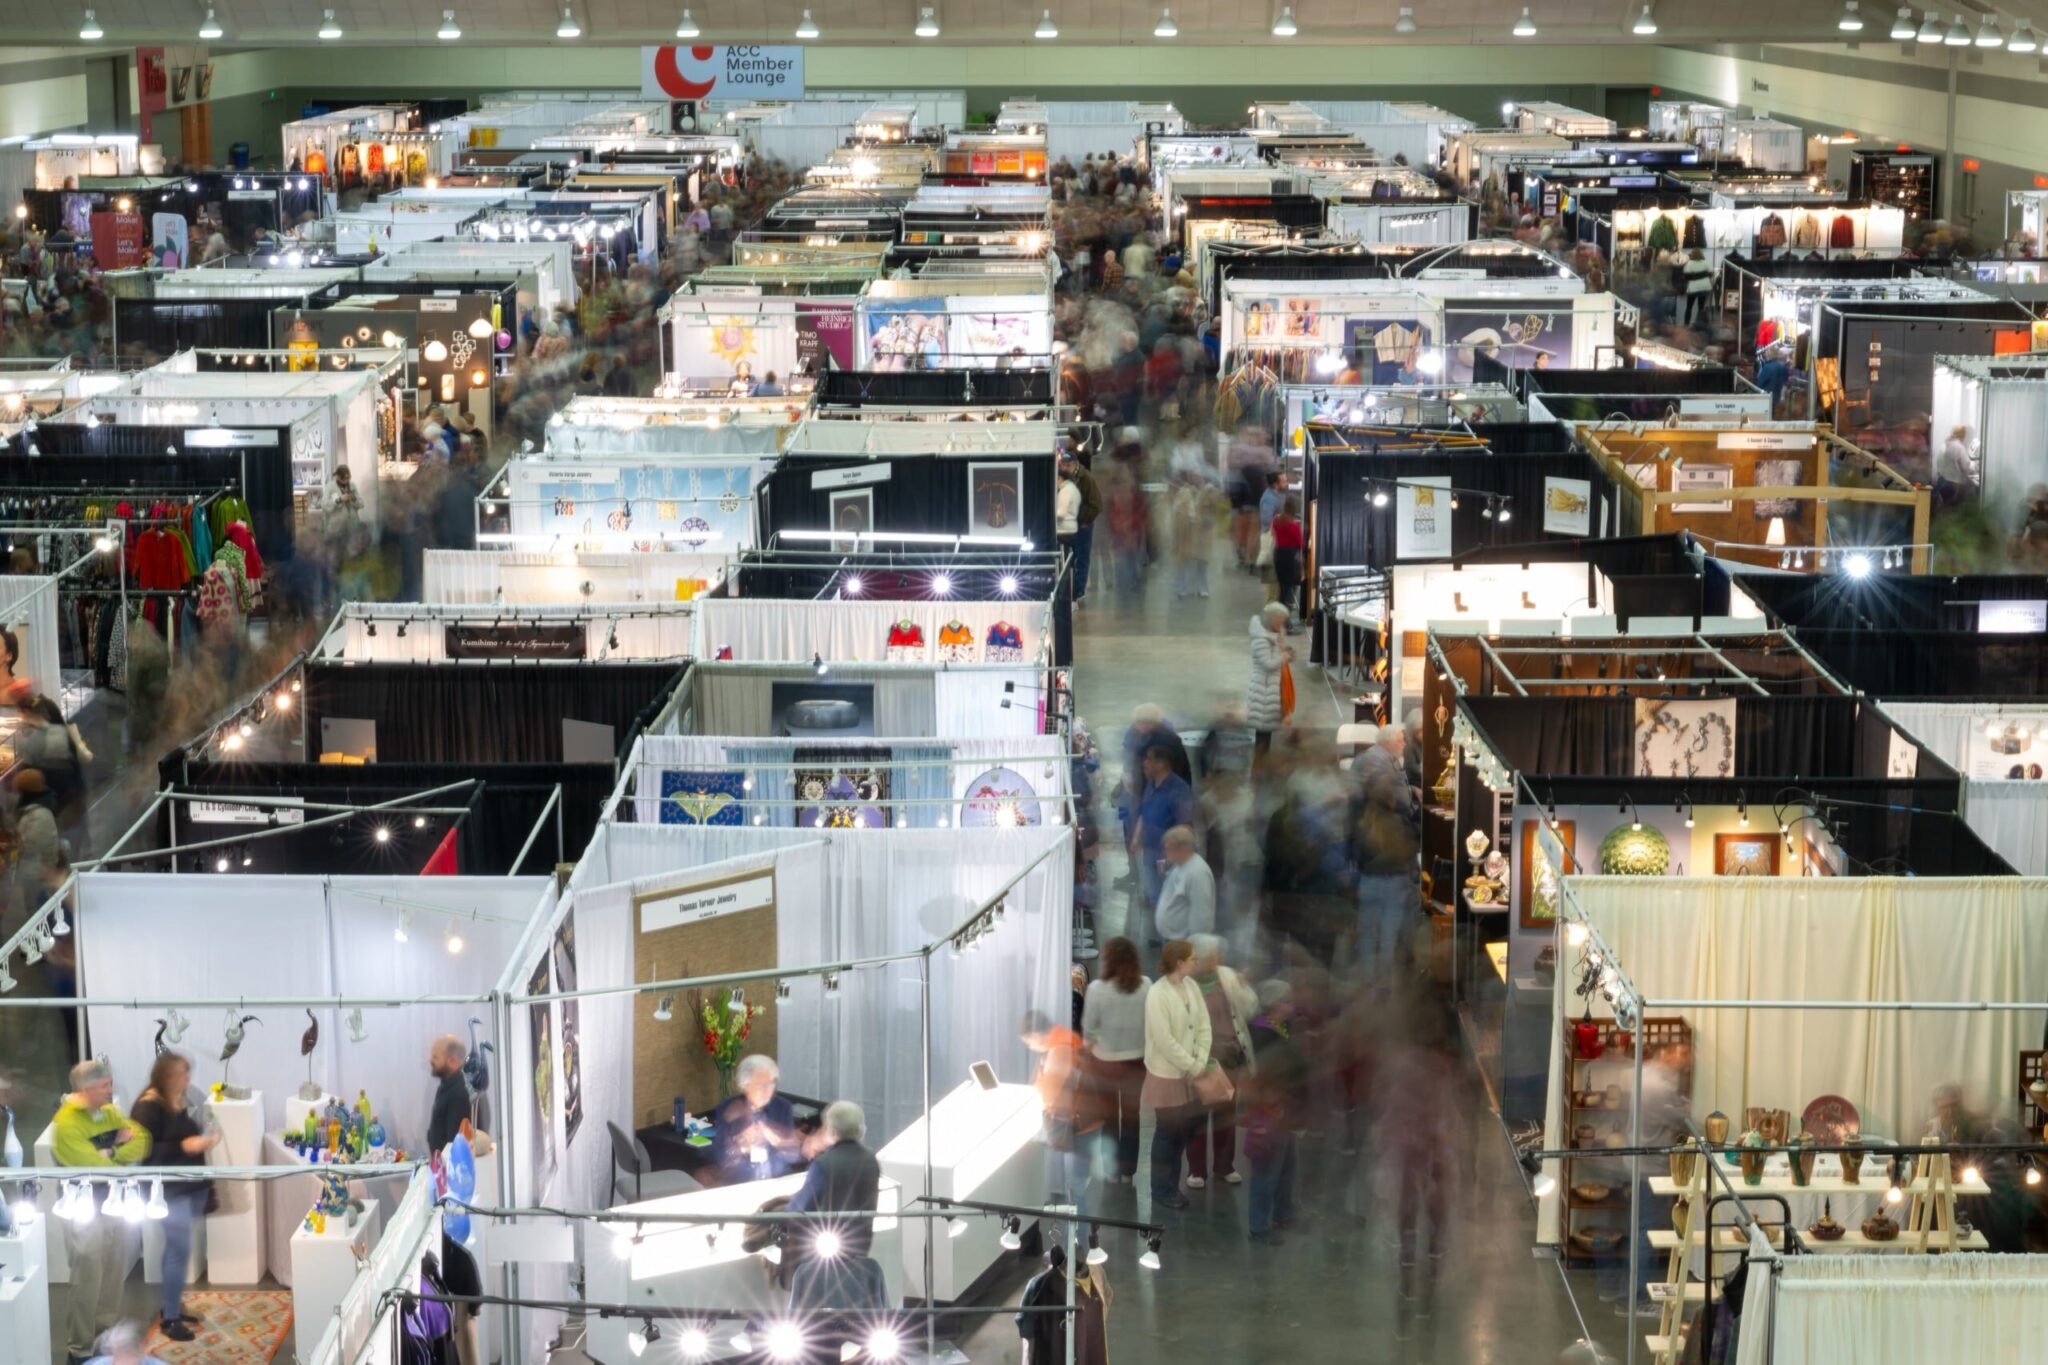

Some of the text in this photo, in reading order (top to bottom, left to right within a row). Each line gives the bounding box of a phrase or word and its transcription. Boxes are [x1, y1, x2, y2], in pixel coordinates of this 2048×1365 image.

[727, 45, 760, 57] ACC
[727, 57, 794, 71] Member
[727, 71, 786, 86] Lounge
[801, 330, 817, 339] TIMO
[461, 639, 498, 647] Kumihimo
[679, 902, 697, 912] Thomas
[716, 893, 737, 904] Jewelry
